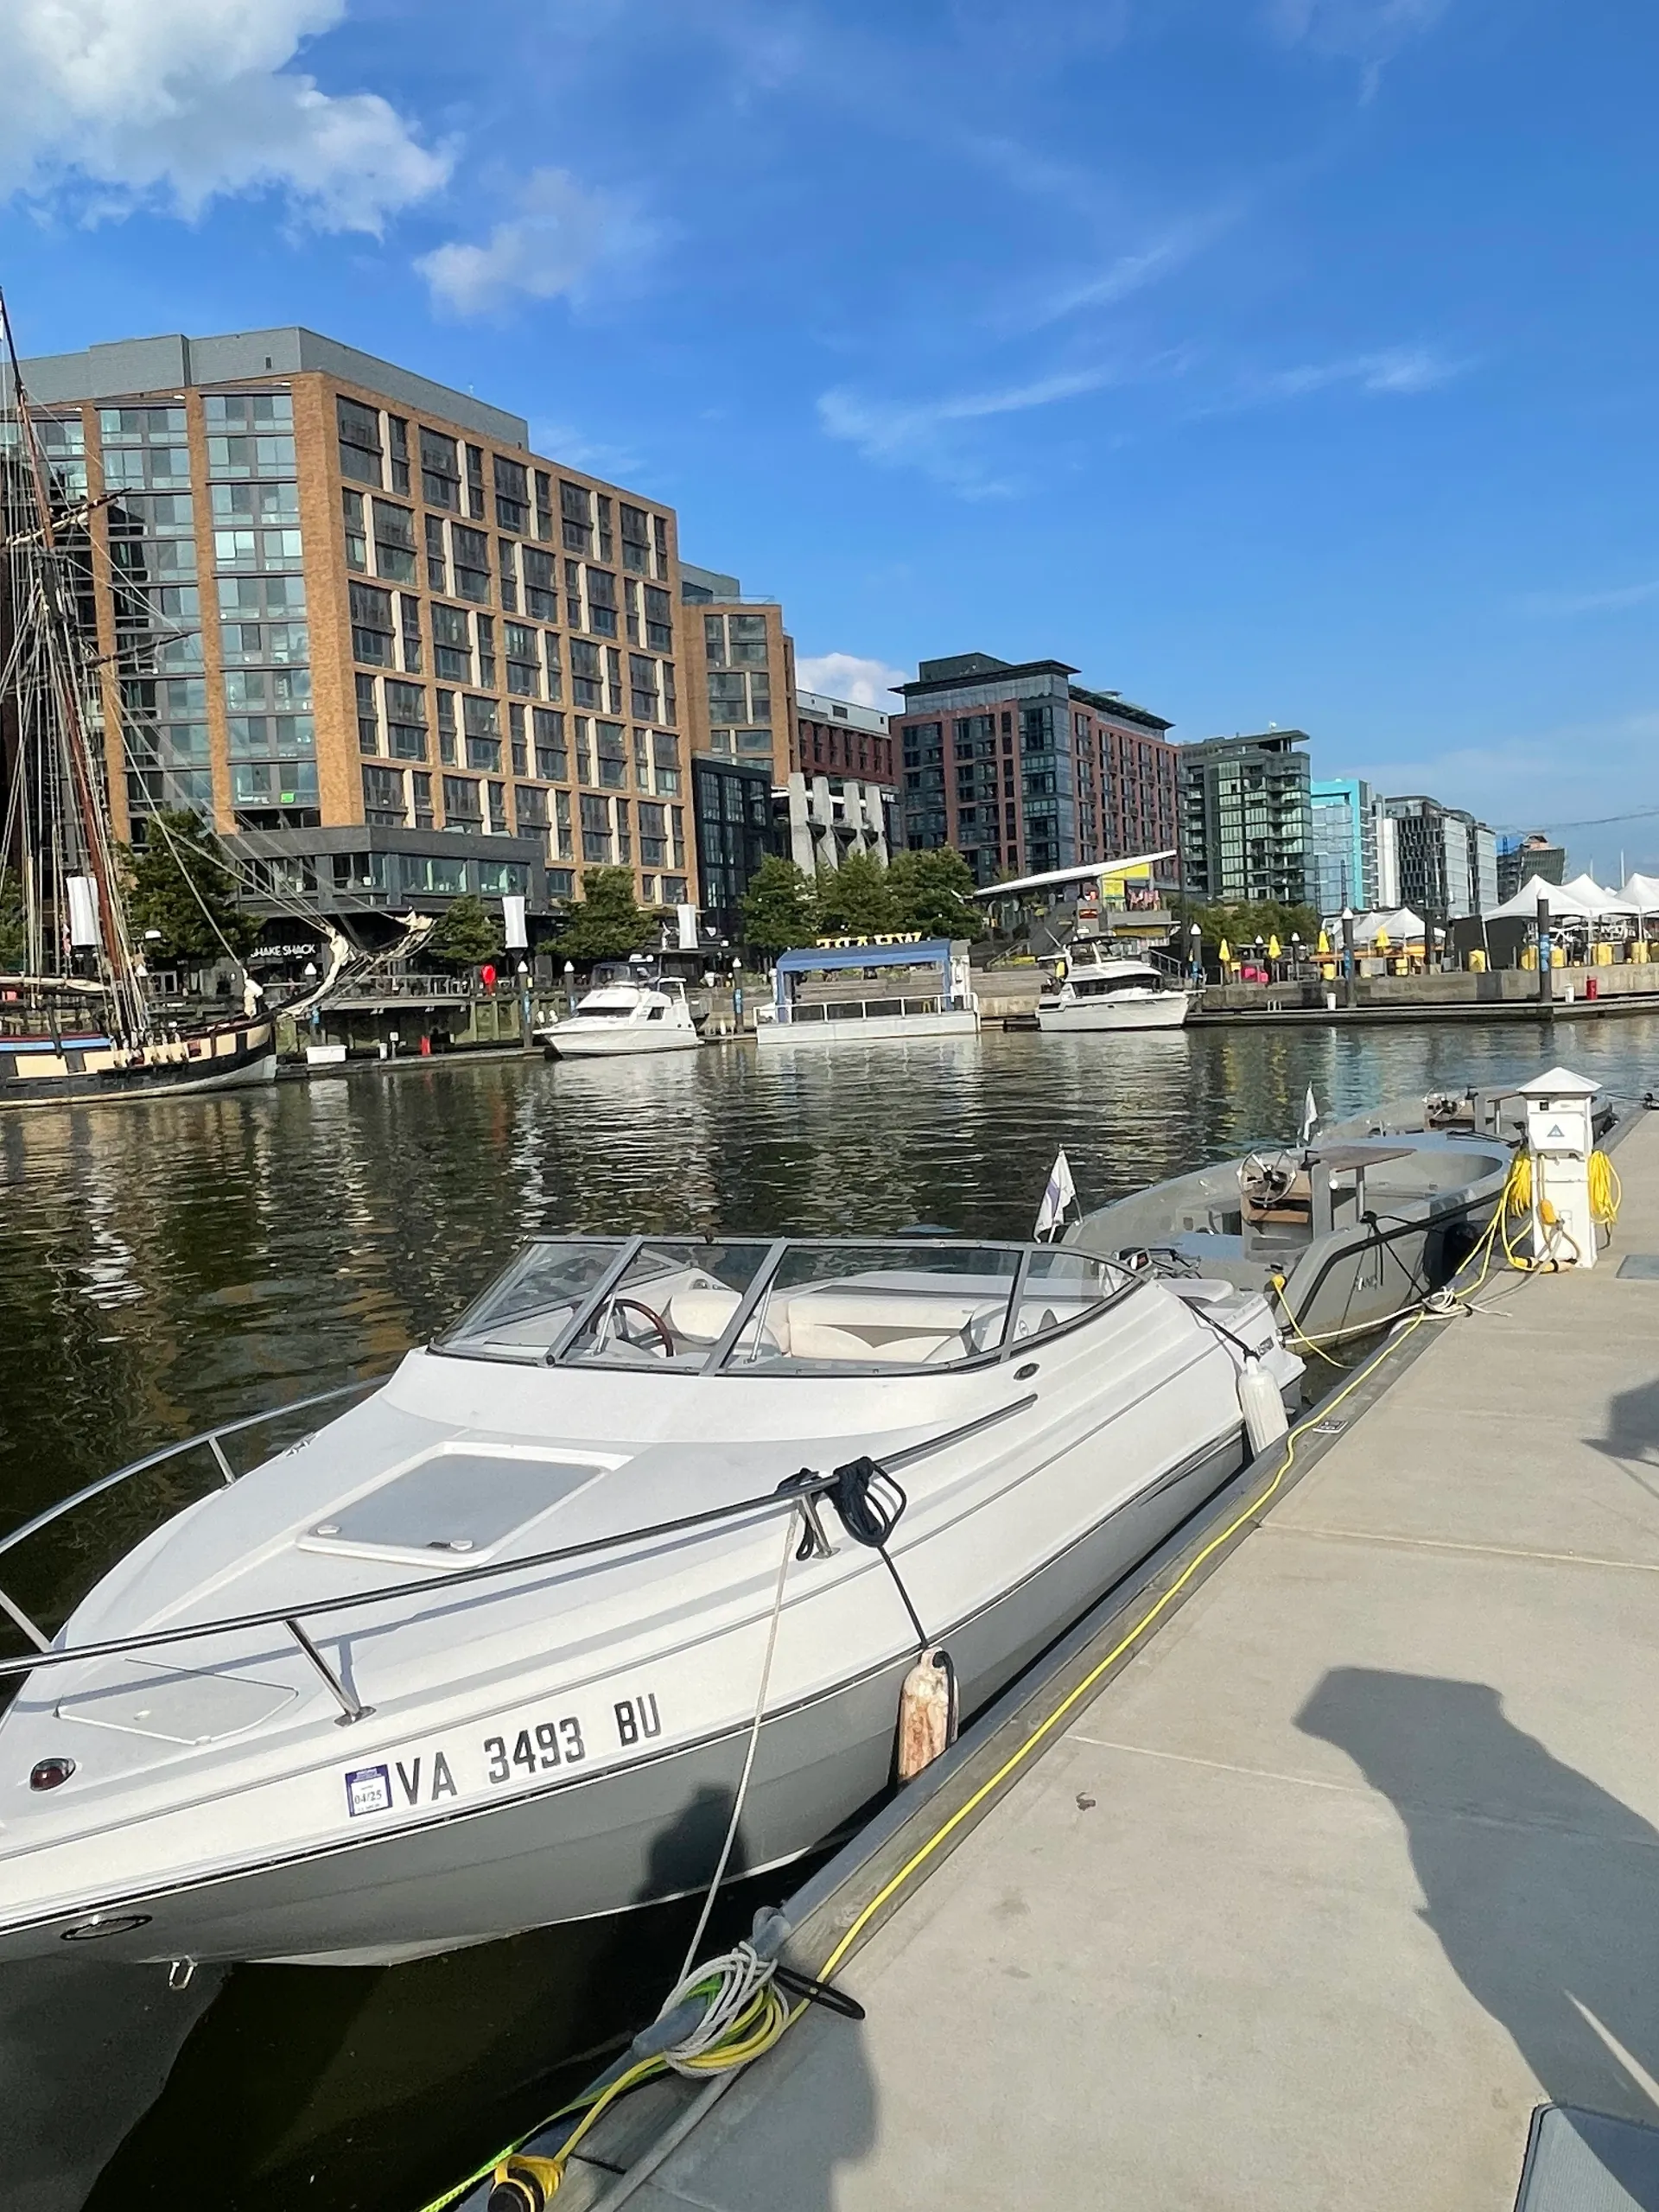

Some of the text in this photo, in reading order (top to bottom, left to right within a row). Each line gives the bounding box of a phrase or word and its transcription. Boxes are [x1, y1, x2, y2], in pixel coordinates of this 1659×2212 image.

[283, 944, 315, 956] SHACK
[396, 1693, 661, 1805] VA 3493 BU
[354, 1789, 382, 1804] 04/25
